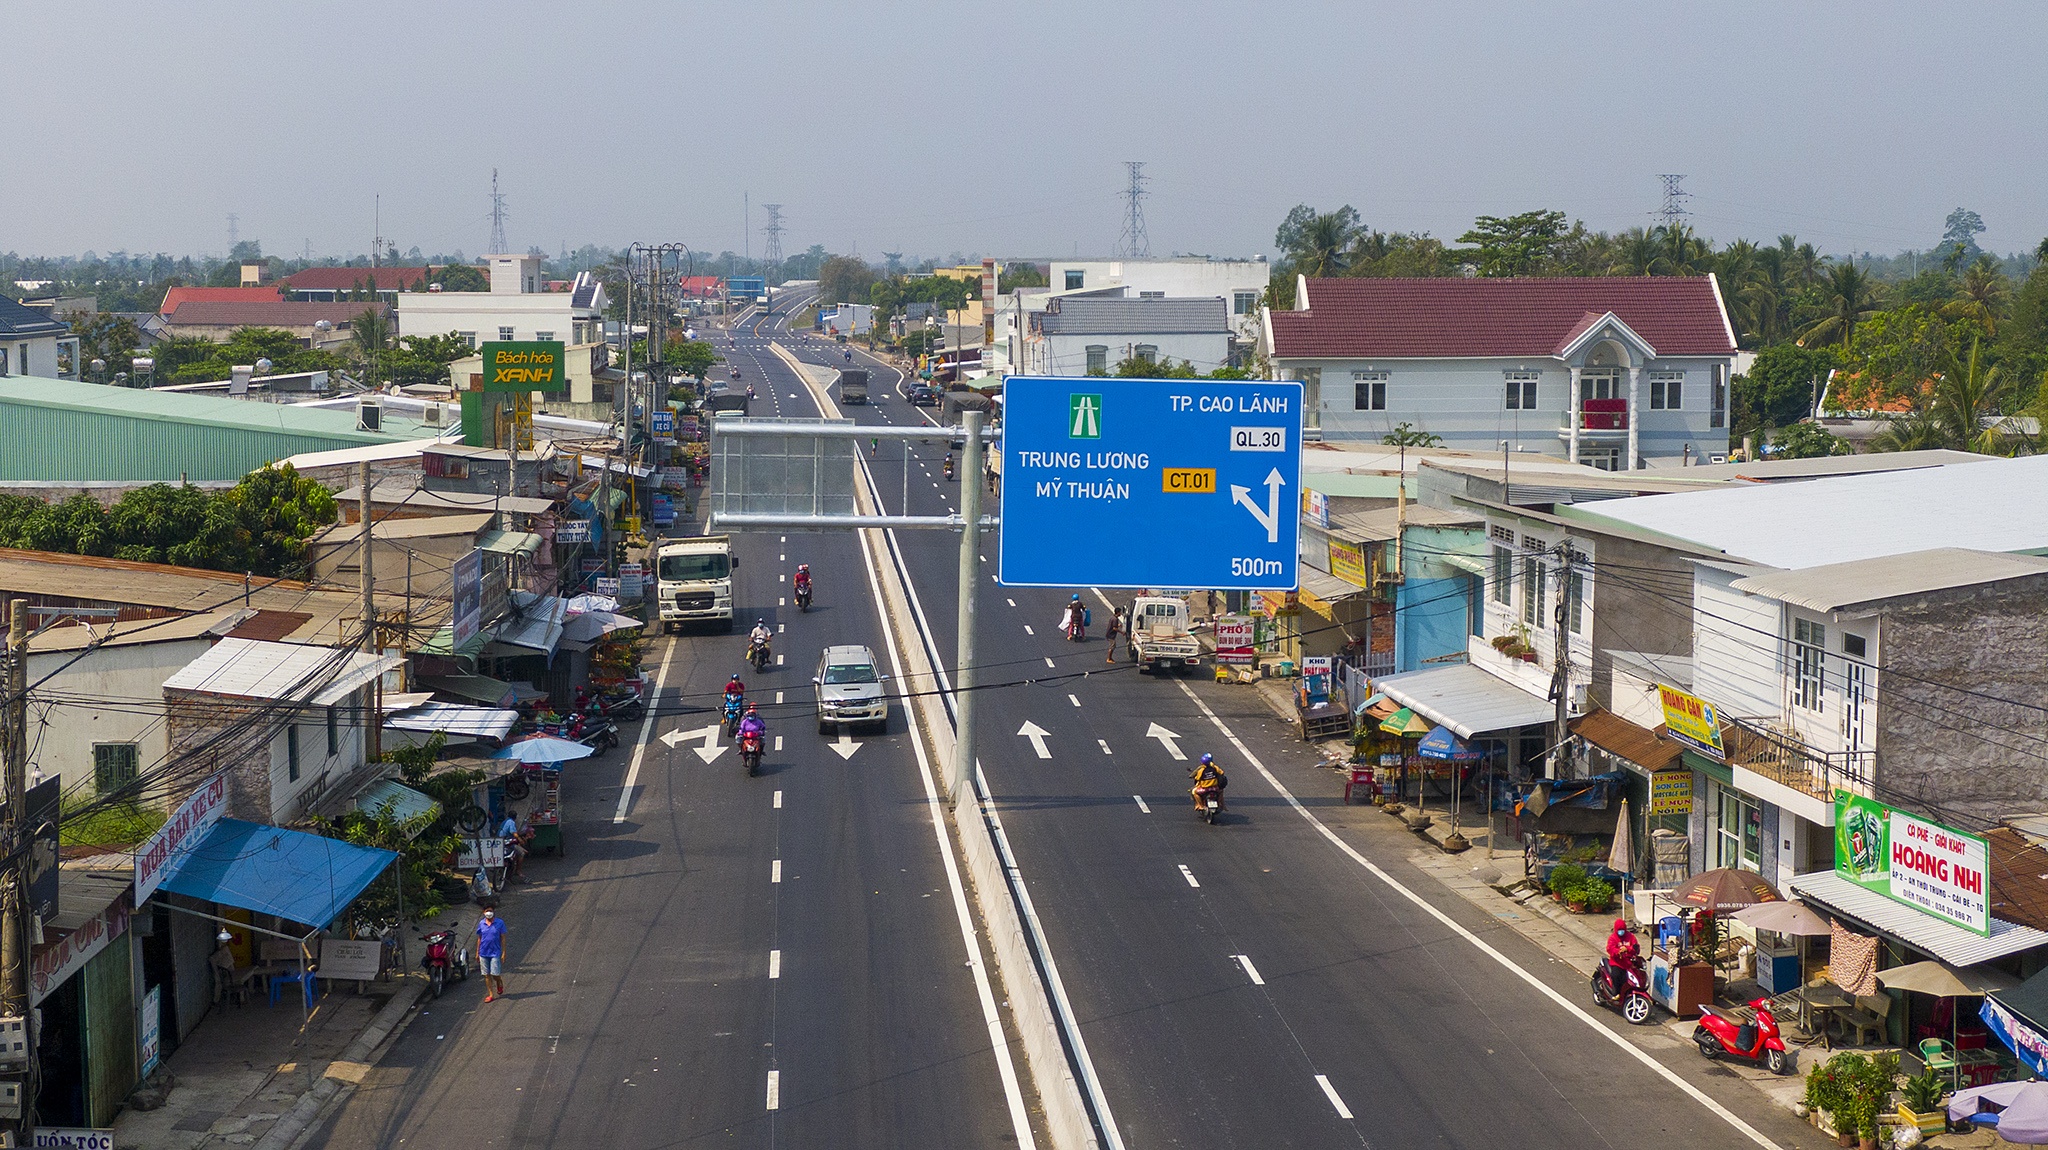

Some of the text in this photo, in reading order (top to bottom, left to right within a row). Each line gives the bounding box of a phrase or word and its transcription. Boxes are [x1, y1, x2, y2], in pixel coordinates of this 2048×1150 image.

[496, 351, 554, 364] Bách hóa
[493, 368, 554, 383] XANH
[1170, 393, 1288, 414] TP. CAO LÃNH
[1236, 432, 1280, 448] QL.30
[1019, 451, 1150, 470] TRUNG LƯƠNG
[1170, 472, 1209, 488] CT.01
[1036, 477, 1130, 503] MỸ THUẬN
[1231, 558, 1283, 576] 500m
[1220, 622, 1244, 634] PHỞ
[192, 792, 206, 826] XE
[1893, 842, 1948, 882] HOÀNG
[1954, 864, 1982, 895] NHI
[1930, 884, 1946, 898] TRUNG
[1976, 902, 1984, 912] TG
[1946, 906, 1954, 916] 35
[76, 1132, 110, 1150] TÓC
